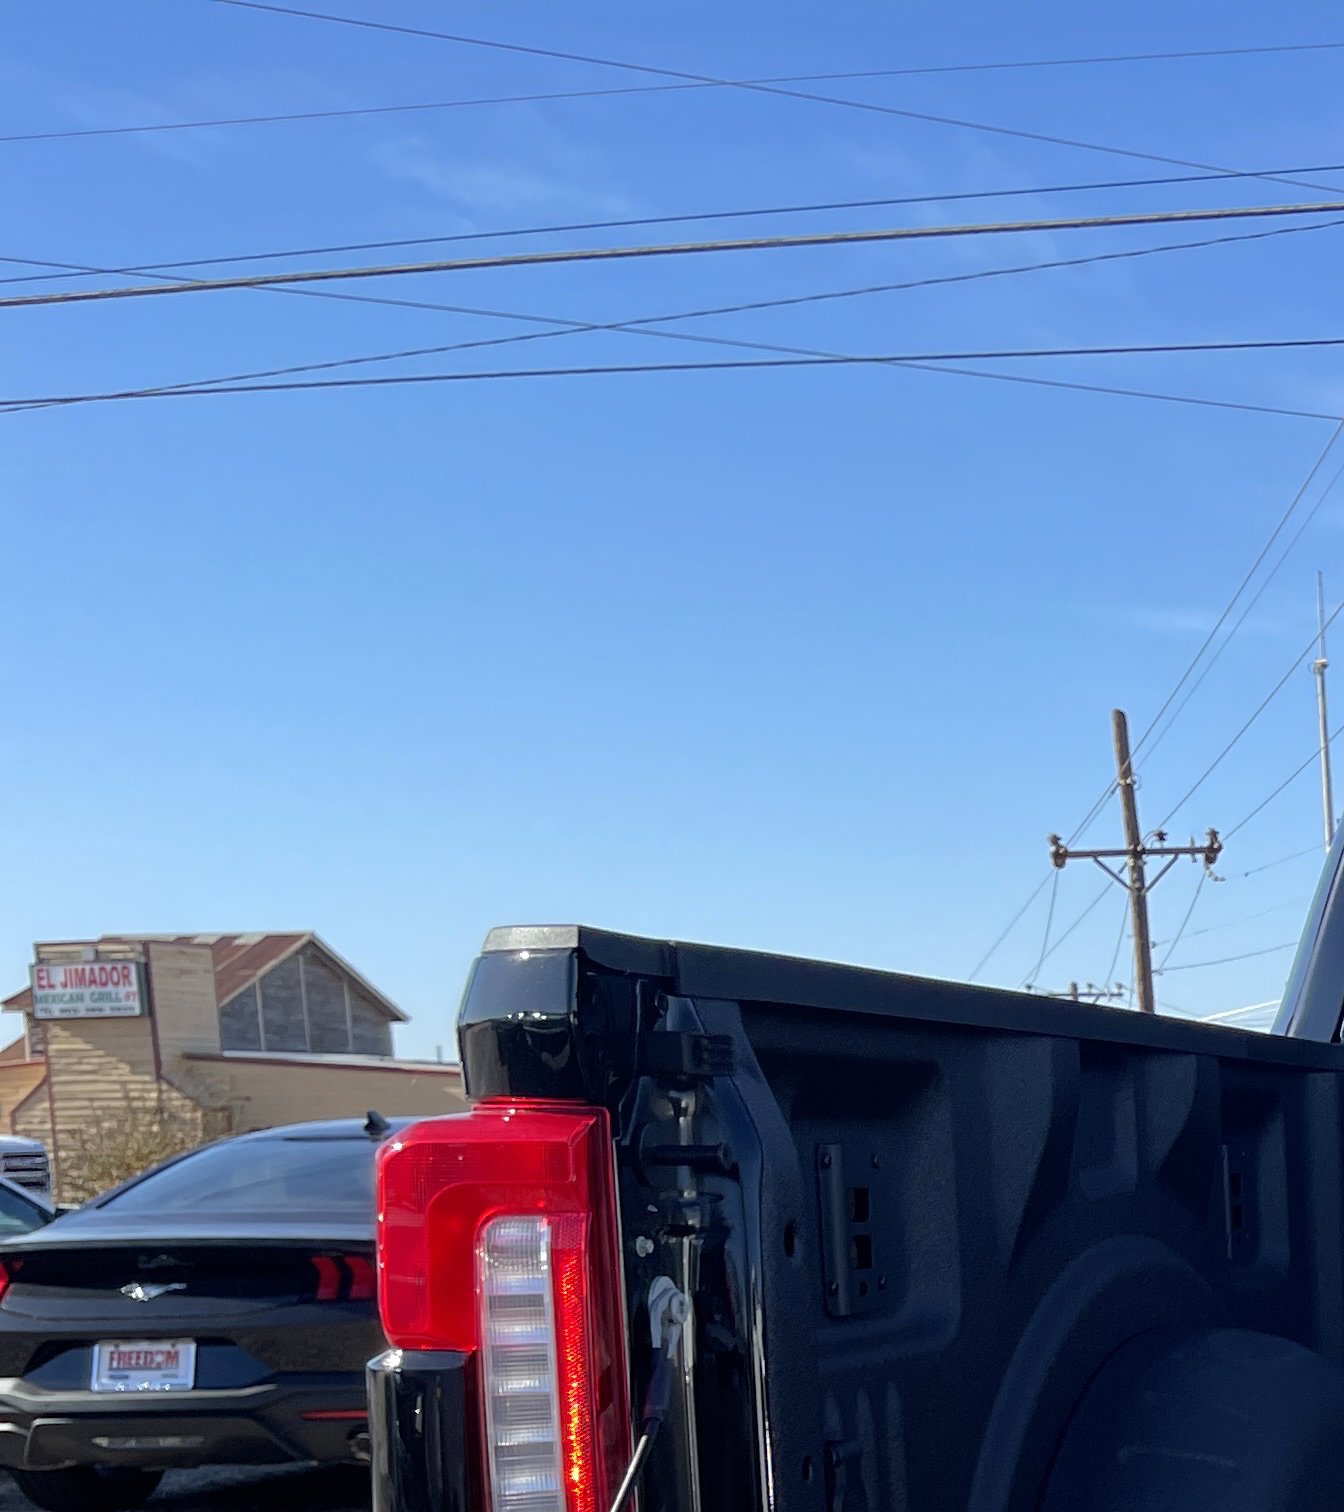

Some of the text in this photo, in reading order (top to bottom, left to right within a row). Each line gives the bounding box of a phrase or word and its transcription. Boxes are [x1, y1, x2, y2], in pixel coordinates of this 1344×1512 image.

[36, 966, 132, 990] EL JIMADOR
[34, 992, 84, 1004] MEXICAN
[89, 990, 122, 1003] GRILL
[109, 1350, 180, 1370] FREEDOM
